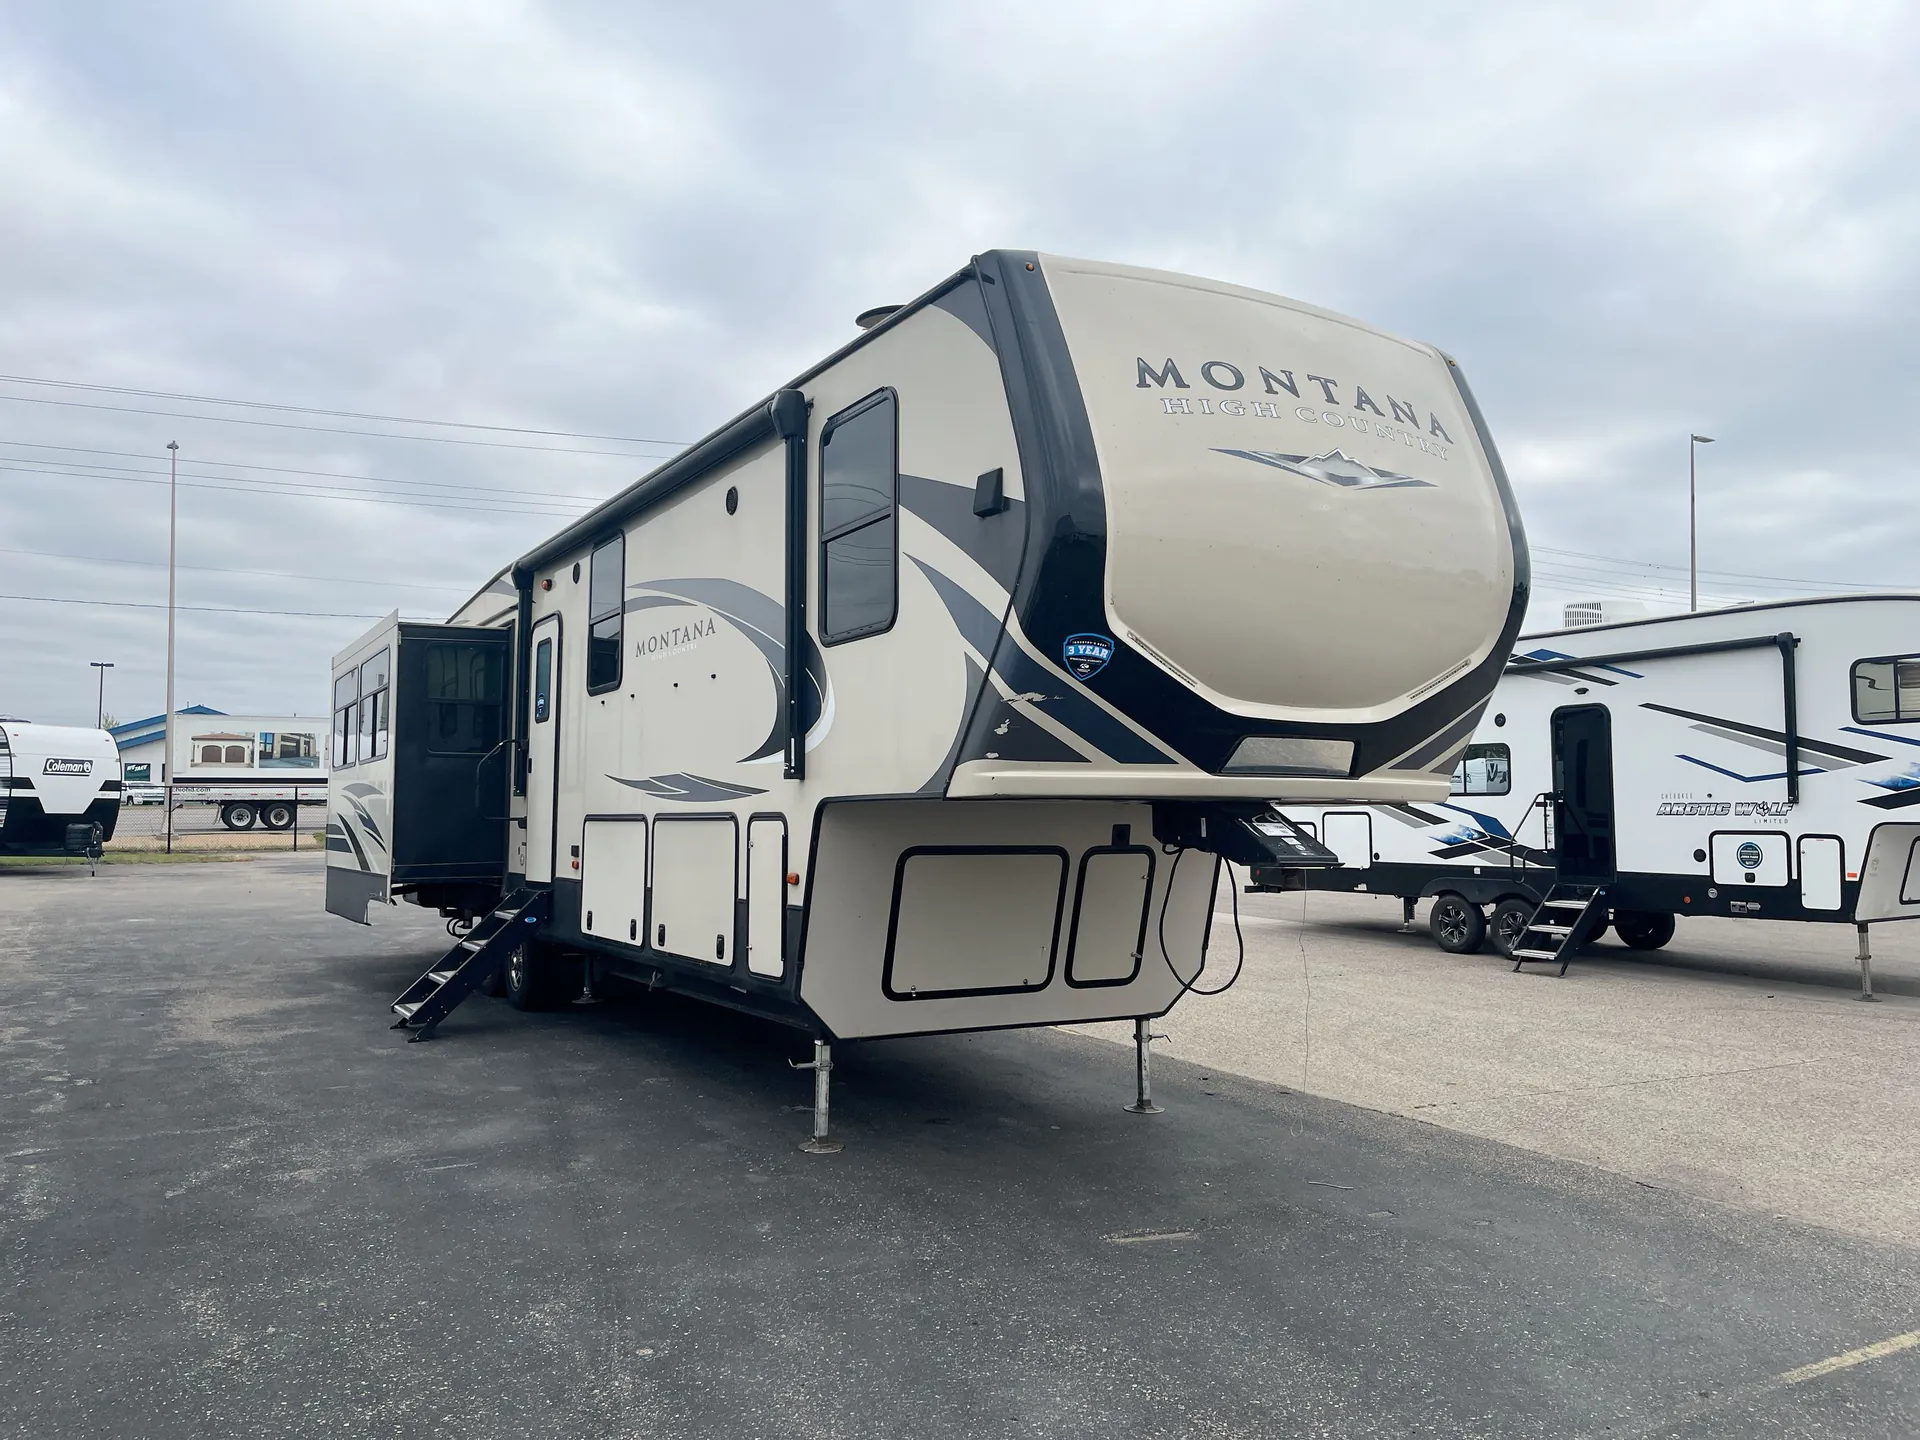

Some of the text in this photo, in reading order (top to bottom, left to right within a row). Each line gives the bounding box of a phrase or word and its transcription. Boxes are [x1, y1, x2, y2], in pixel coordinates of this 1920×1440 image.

[1136, 356, 1454, 445] MONTANA
[1160, 397, 1448, 461] HIGH COUNTRY
[635, 617, 716, 657] MONTANA
[1068, 645, 1108, 658] 3 YEAR
[46, 759, 83, 773] Coleman
[1656, 801, 1795, 817] ARCTIC WOLF
